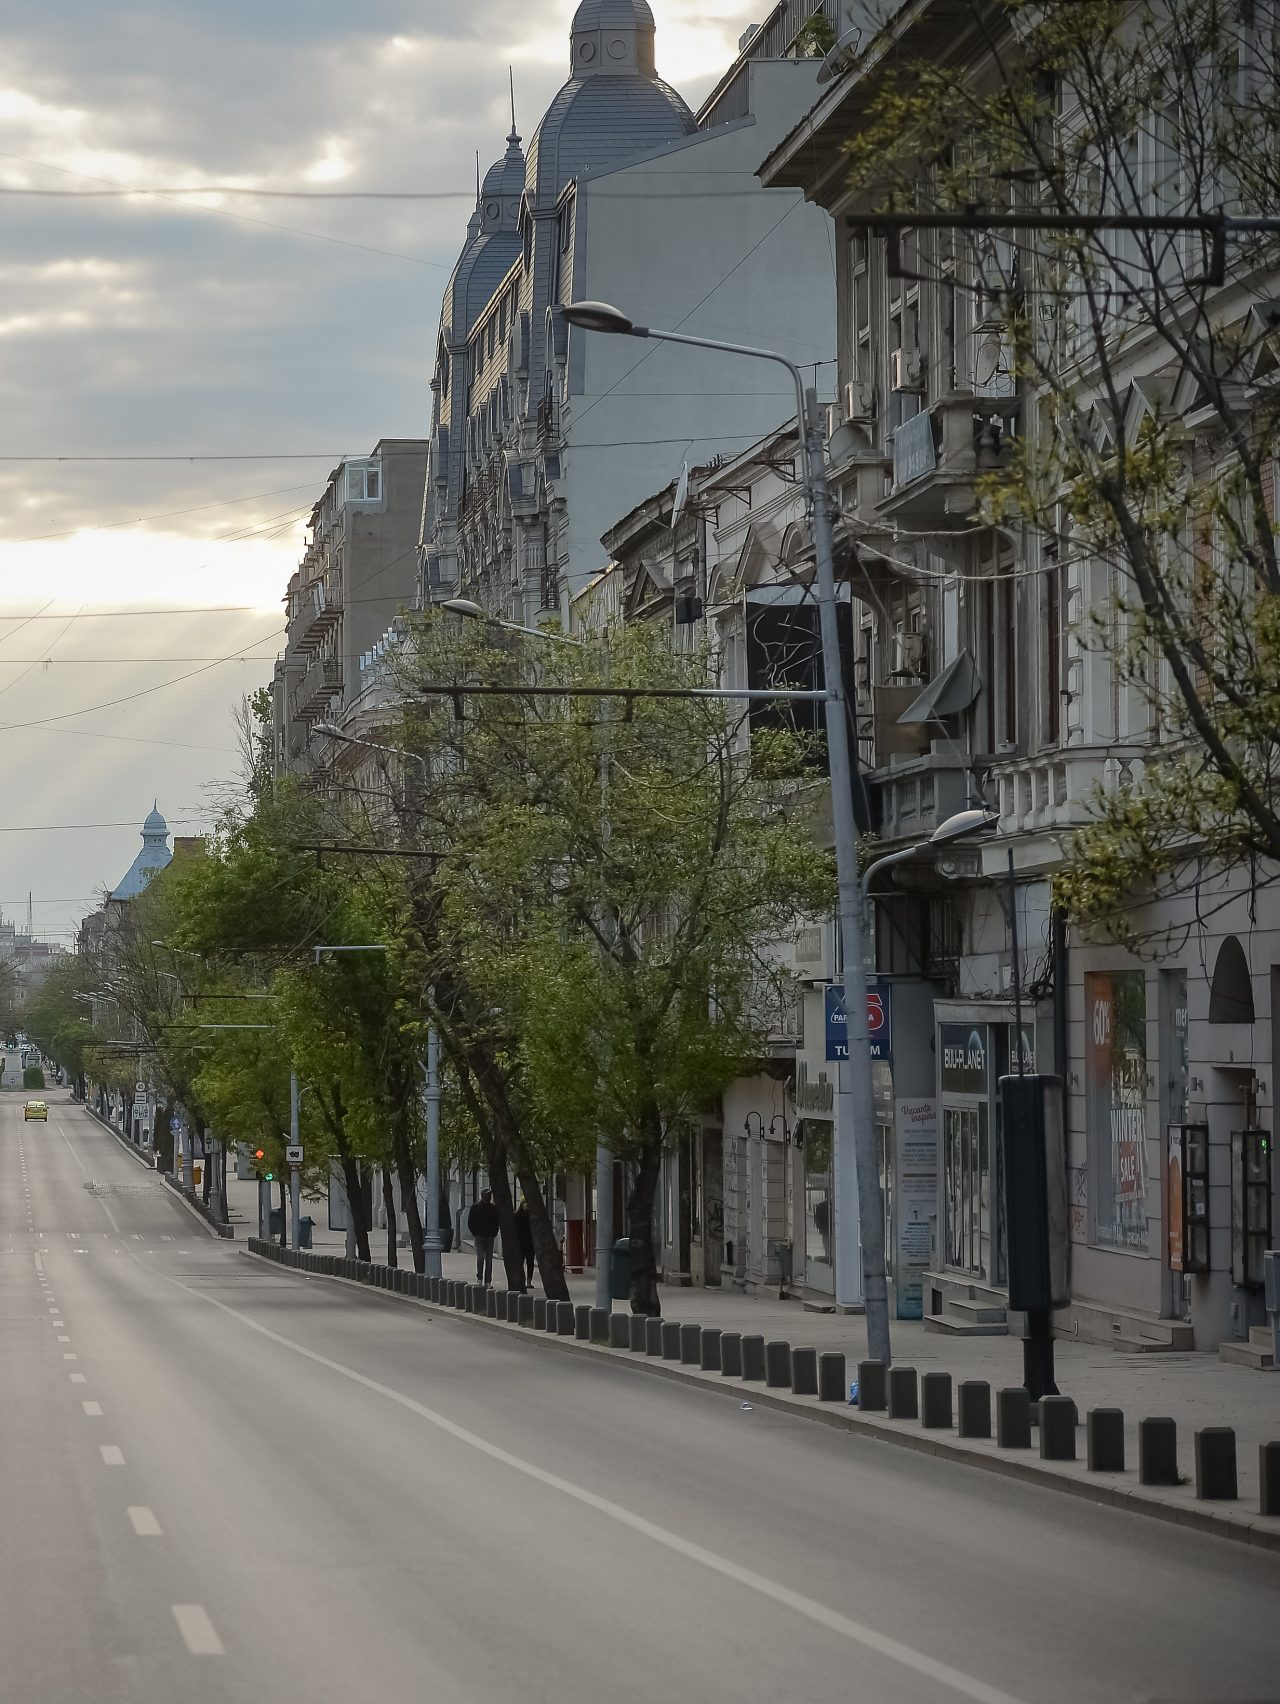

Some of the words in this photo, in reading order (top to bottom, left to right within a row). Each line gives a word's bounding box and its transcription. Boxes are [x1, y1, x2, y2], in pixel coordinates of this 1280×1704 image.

[835, 1045, 881, 1056] TUM
[1110, 1109, 1144, 1143] WINTER
[1120, 1155, 1136, 1184] SALE
